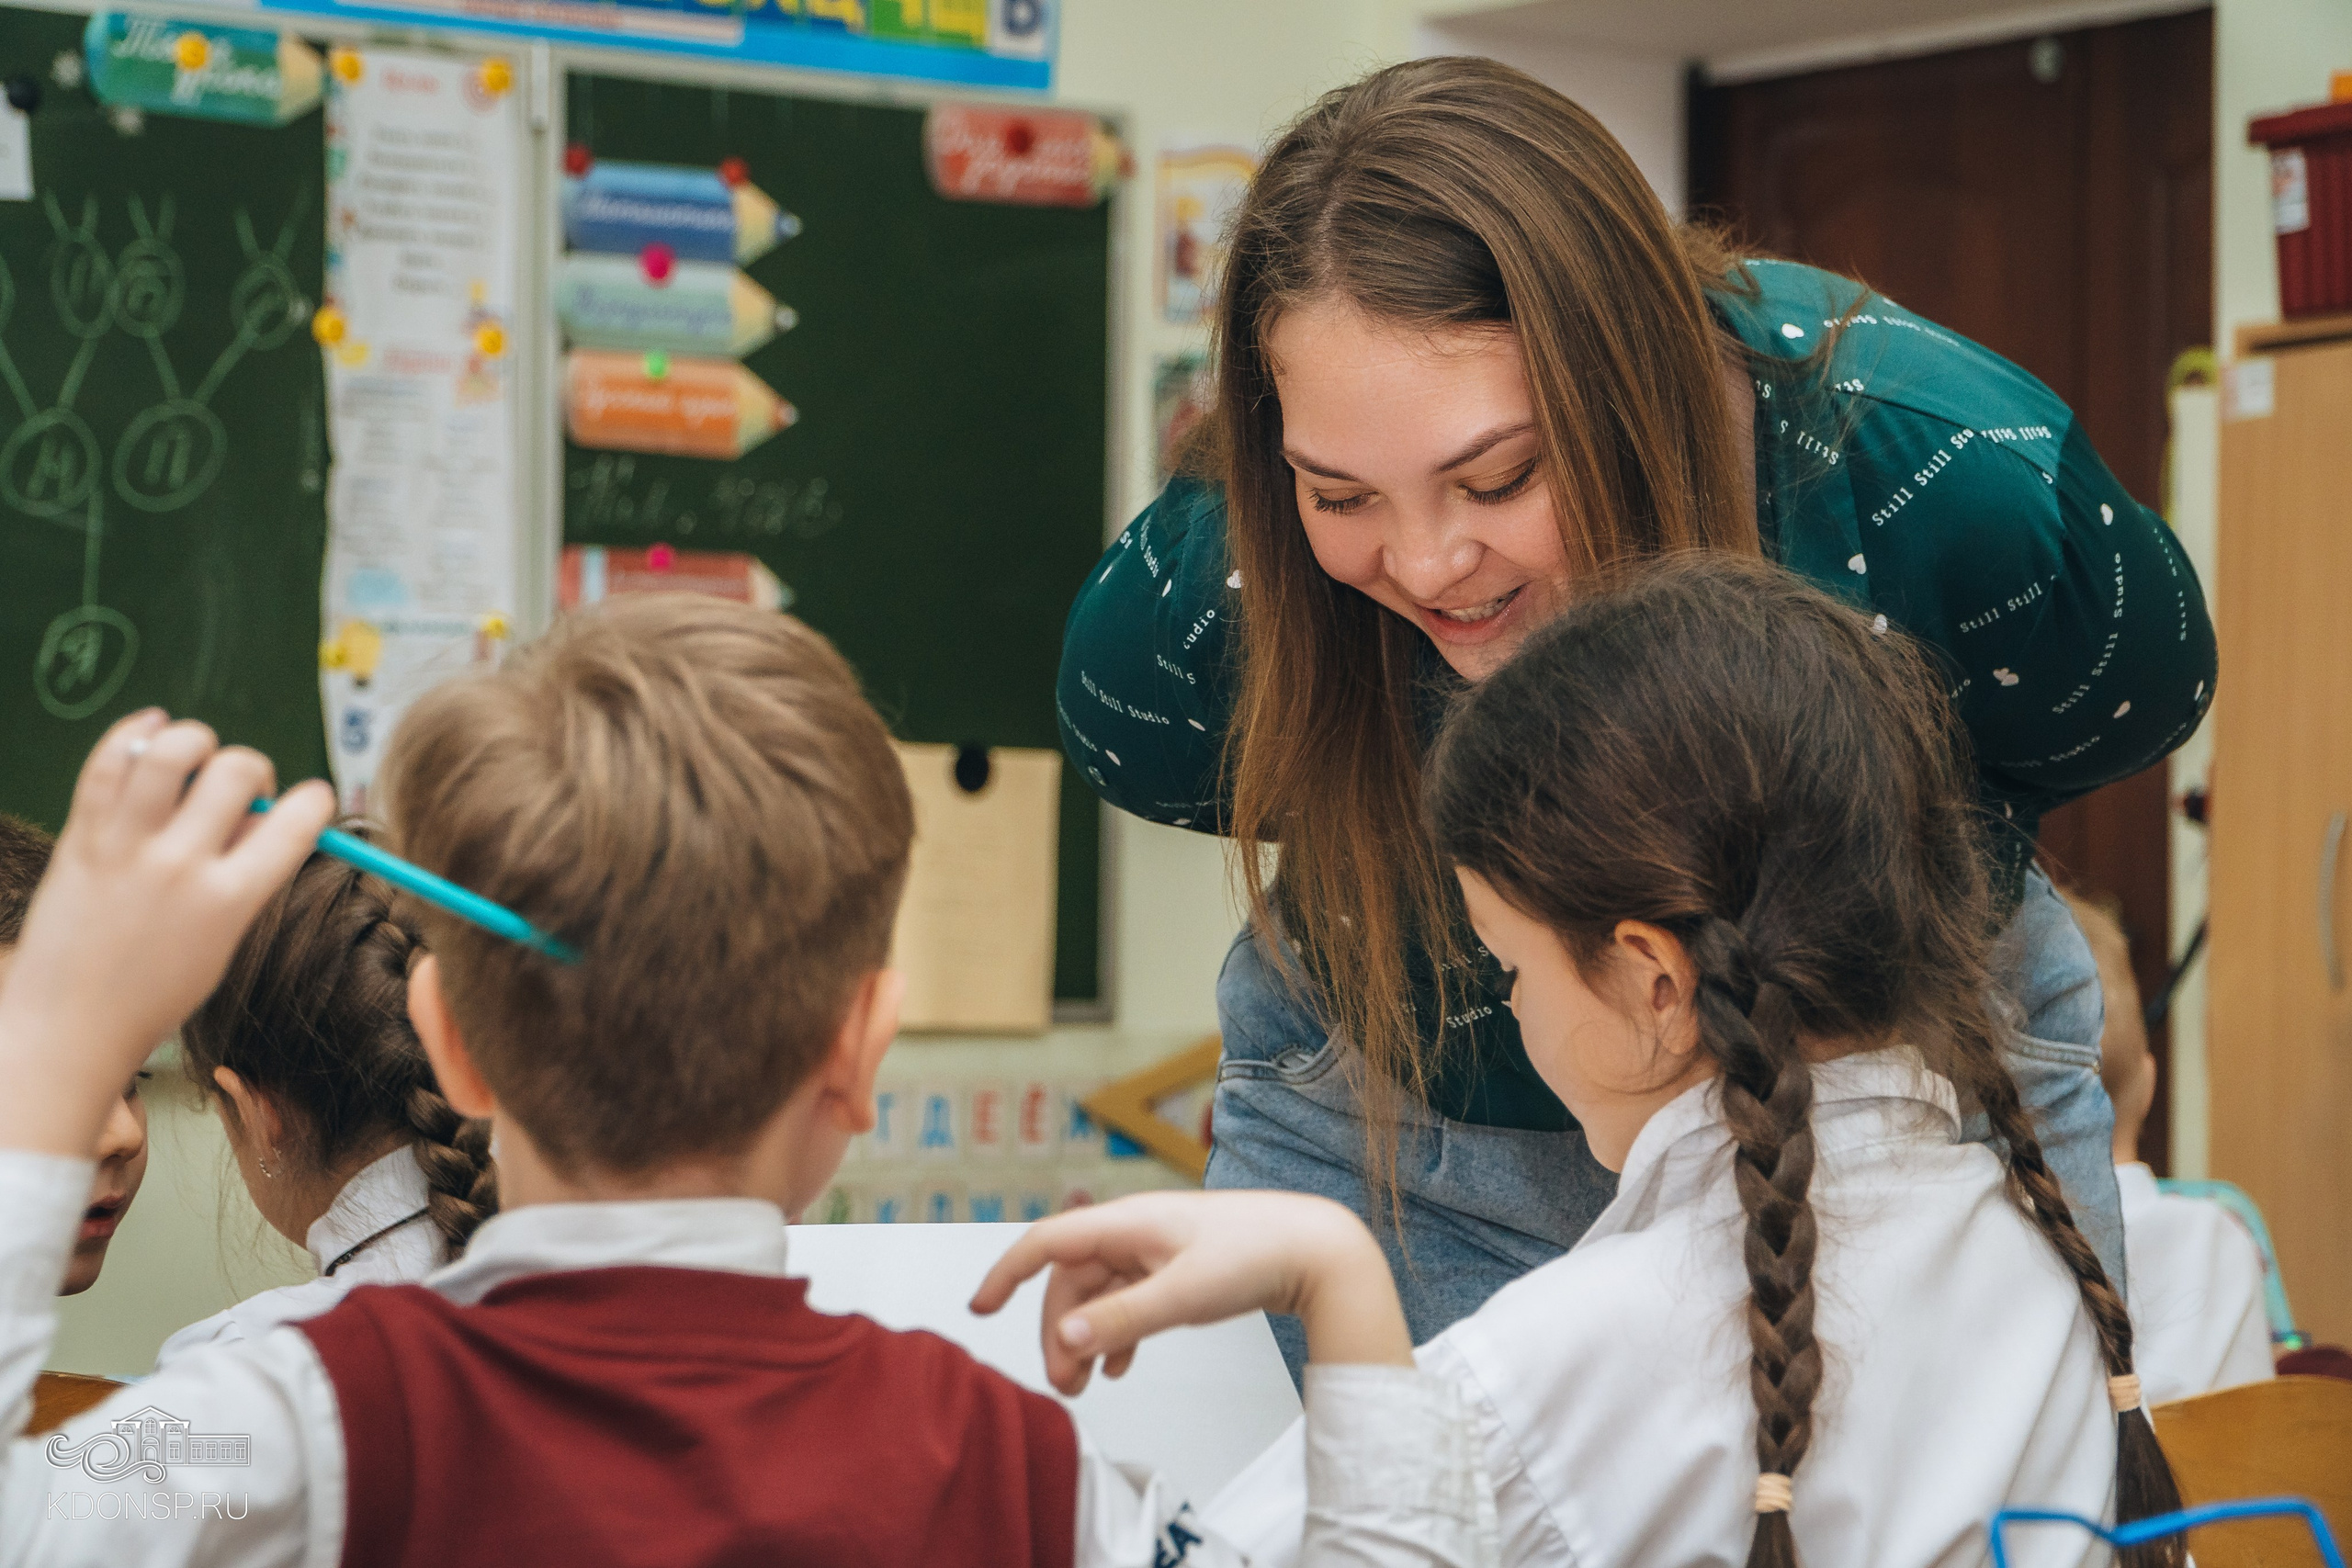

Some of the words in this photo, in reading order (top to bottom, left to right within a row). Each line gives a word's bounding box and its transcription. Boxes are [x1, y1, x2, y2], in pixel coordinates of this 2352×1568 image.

[1796, 431, 1839, 466] Still
[1871, 487, 1914, 526] Still
[1914, 448, 1952, 487] Still
[2113, 552, 2124, 619] Studio
[1960, 607, 2001, 633] Still
[2007, 581, 2044, 612] Still
[1156, 654, 1184, 680] Still
[1099, 689, 1124, 714] Still
[1126, 705, 1170, 726] Studio
[1445, 1005, 1493, 1030] Studio
